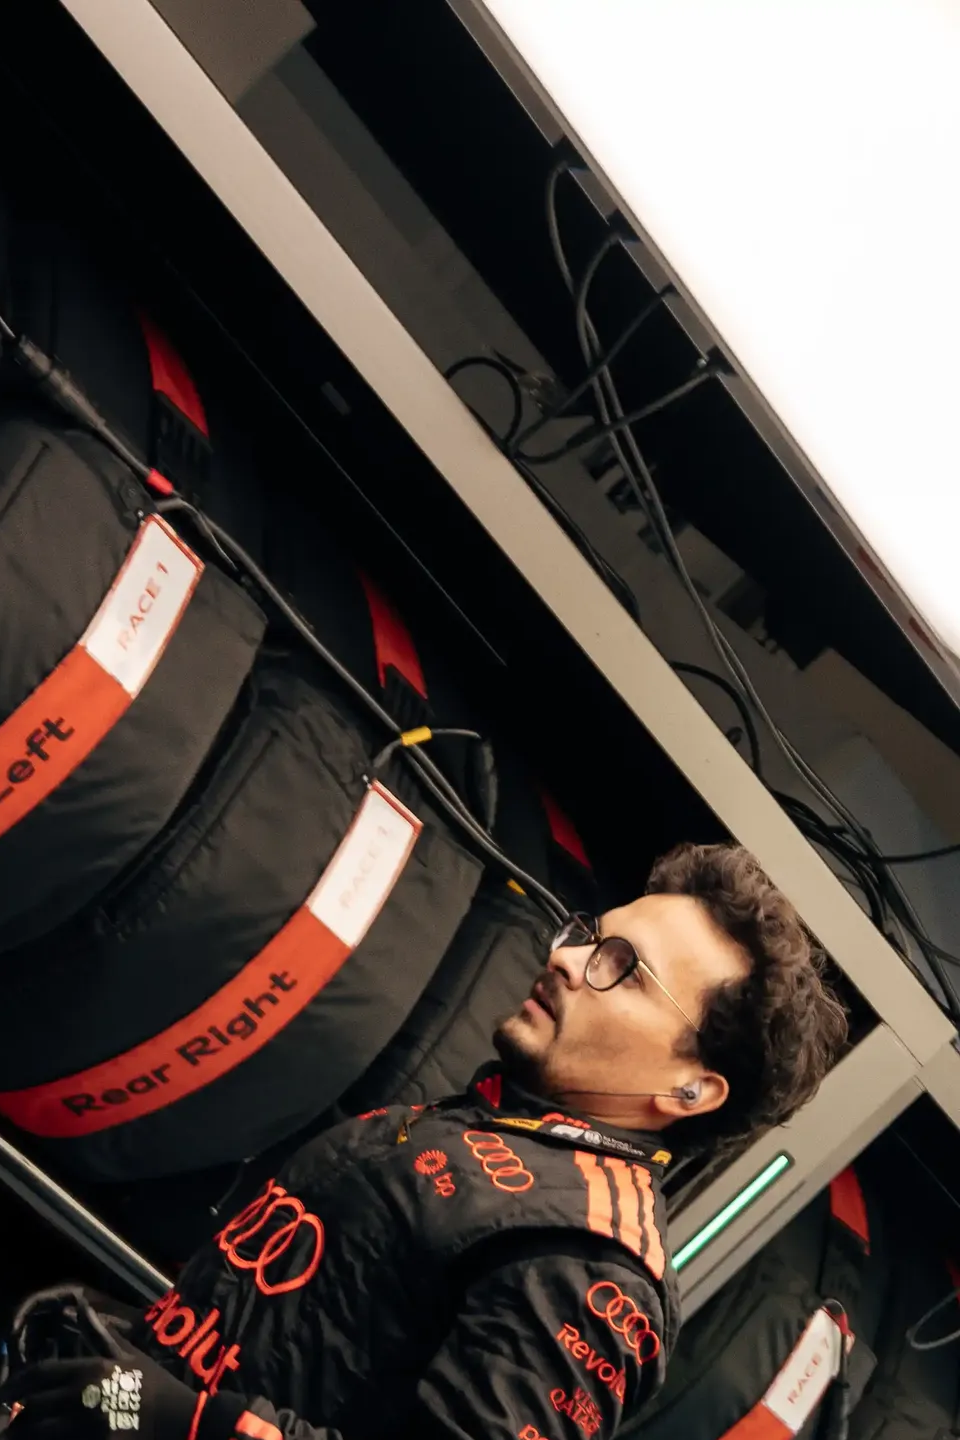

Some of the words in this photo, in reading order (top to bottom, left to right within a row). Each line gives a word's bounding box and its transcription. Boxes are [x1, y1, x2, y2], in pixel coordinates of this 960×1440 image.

[115, 579, 163, 651] RACE
[61, 1060, 172, 1118] Rear
[175, 969, 298, 1067] Right
[786, 1351, 822, 1405] RACE
